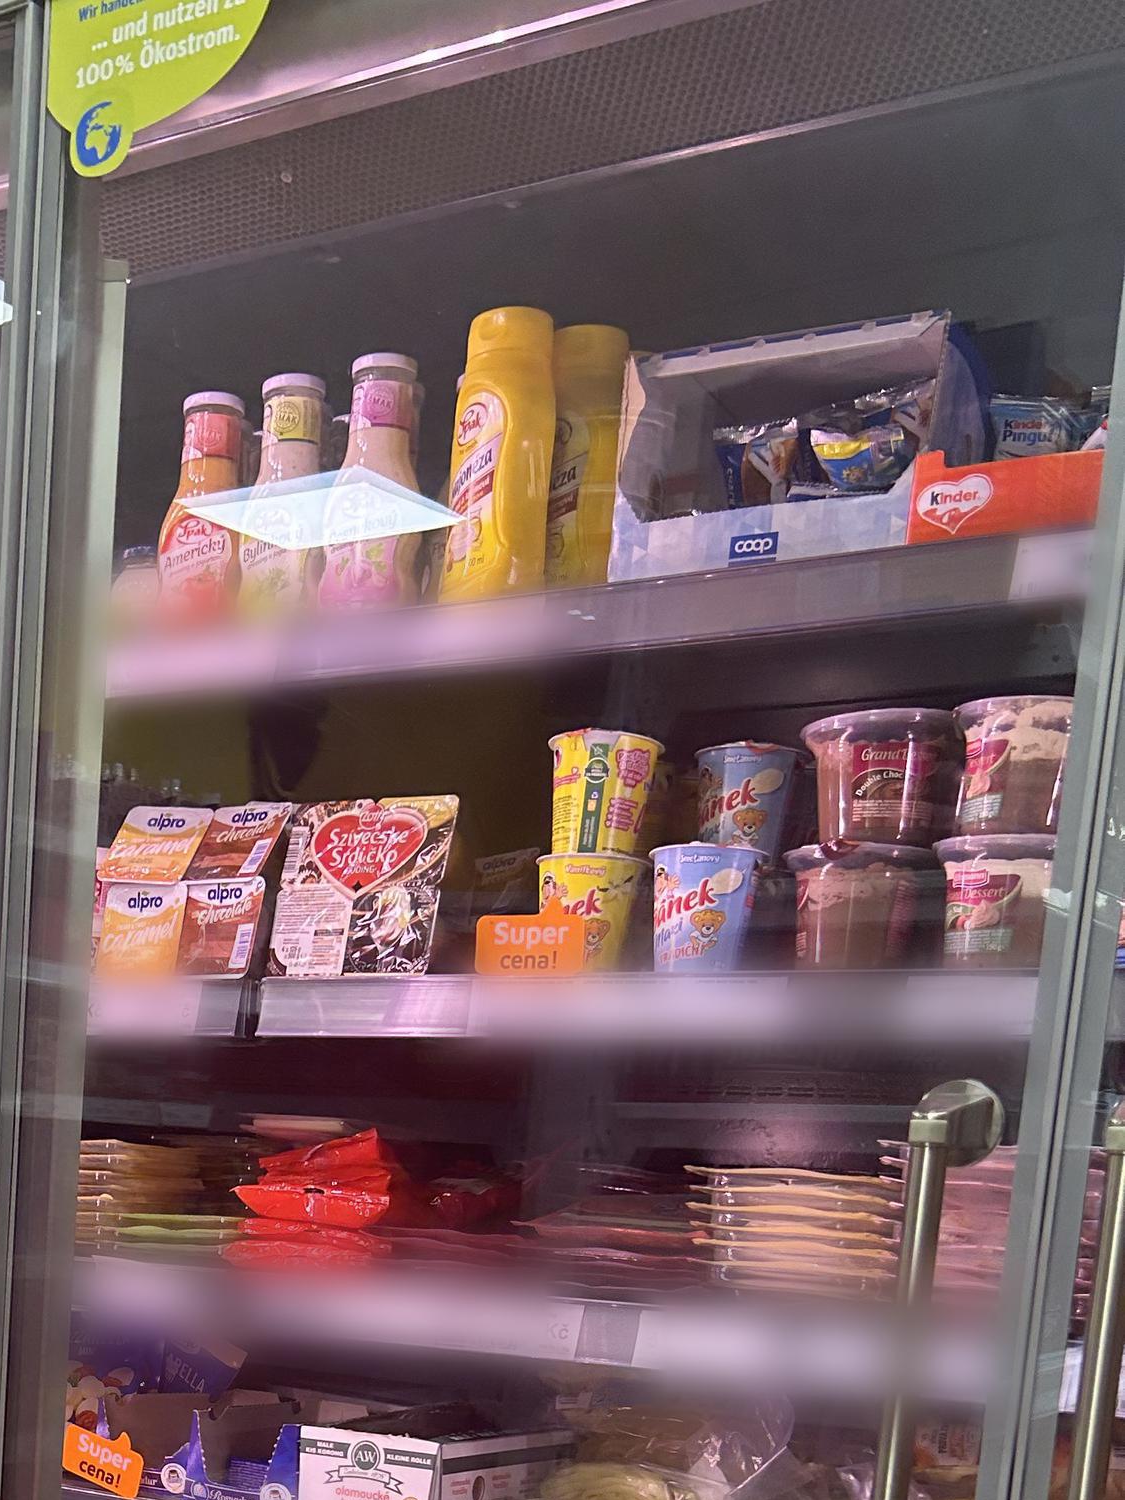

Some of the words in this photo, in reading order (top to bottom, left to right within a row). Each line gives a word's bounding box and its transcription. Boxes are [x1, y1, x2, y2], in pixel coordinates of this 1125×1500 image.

[79, 6, 97, 22] Wir
[112, 11, 147, 44] und
[76, 53, 134, 88] 100%
[140, 24, 240, 69] Ökostrom.
[164, 534, 226, 571] Americký
[734, 536, 773, 554] coop
[861, 747, 898, 762] Grand
[855, 773, 882, 797] Double
[148, 813, 186, 831] alpro
[232, 809, 268, 828] alpro
[216, 820, 275, 844] chocolate
[128, 891, 163, 912] alpro
[208, 883, 243, 904] alpro
[197, 898, 253, 925] chocolate
[493, 922, 569, 949] Super
[499, 949, 558, 971] cena!
[78, 1433, 132, 1471] Super
[386, 1453, 410, 1463] KLEINE
[411, 1456, 432, 1466] ROLLE
[79, 1460, 121, 1488] cena!
